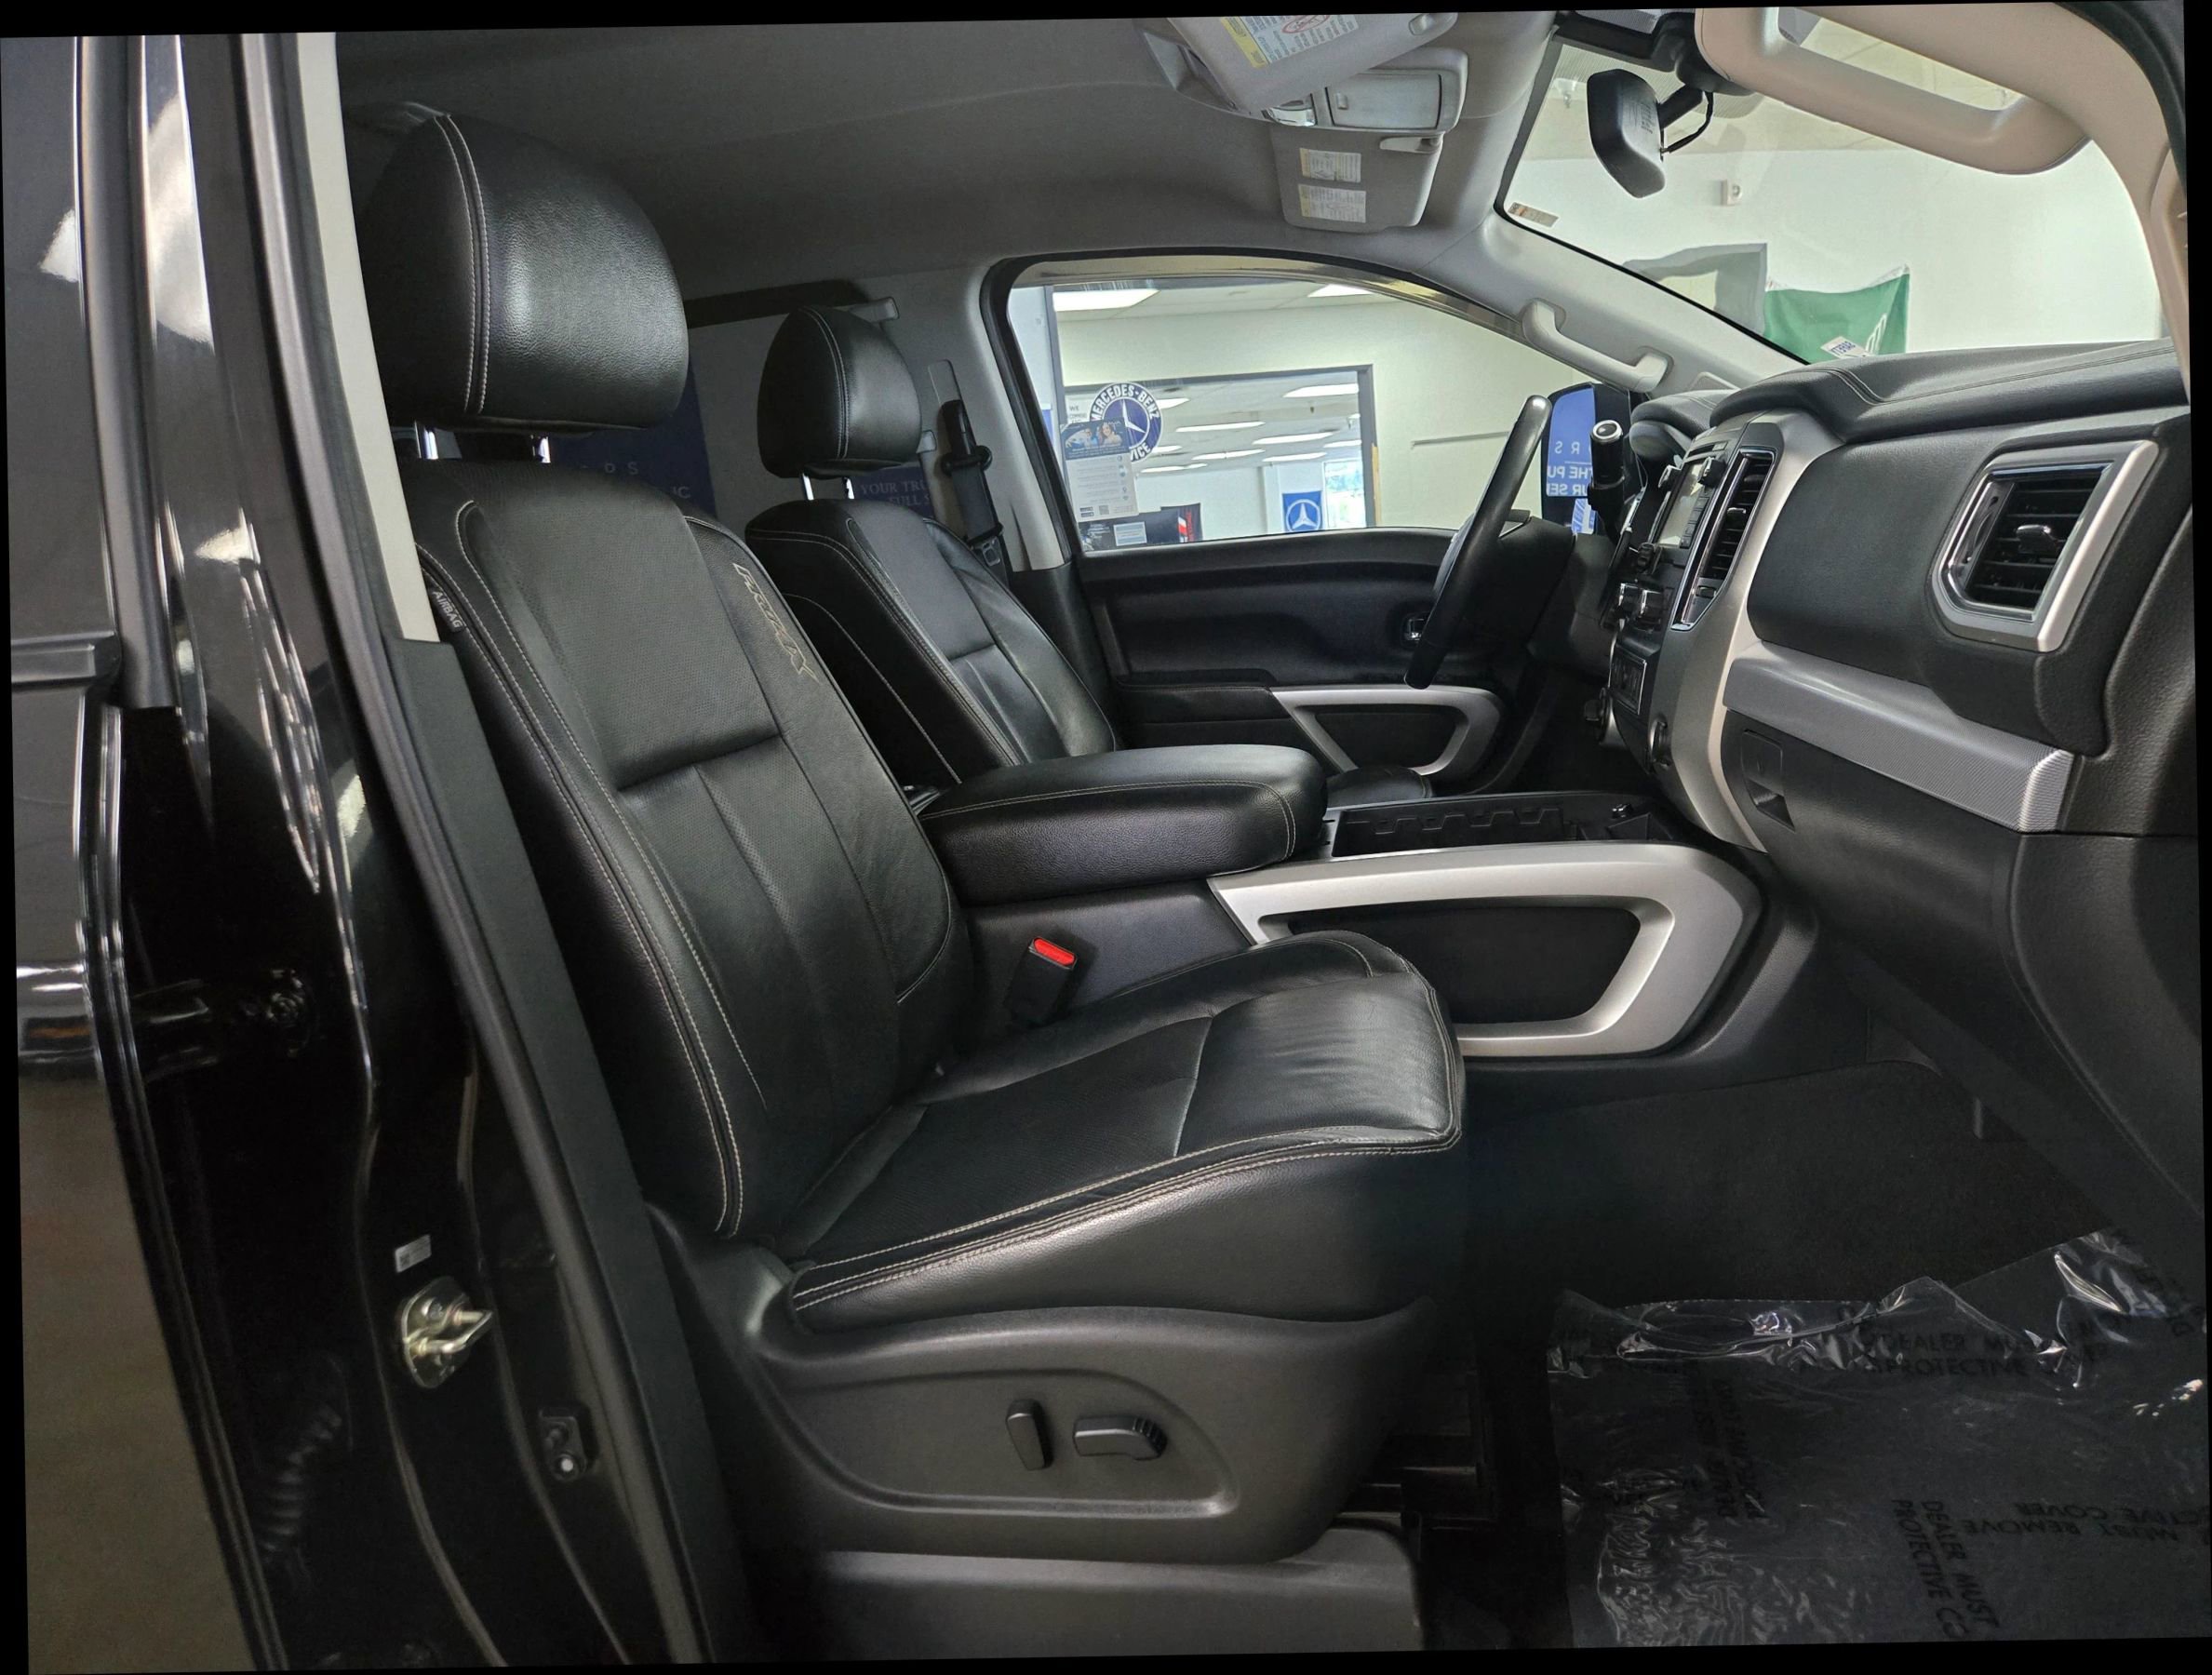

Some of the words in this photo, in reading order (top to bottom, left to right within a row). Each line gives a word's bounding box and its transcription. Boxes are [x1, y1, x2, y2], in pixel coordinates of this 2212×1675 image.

[860, 482, 898, 495] YOUR
[432, 591, 463, 628] AIRBAG
[1890, 1498, 1953, 1599] PROTECTIVE
[1920, 1500, 1966, 1560] DEALER
[1951, 1573, 2000, 1628] MUST
